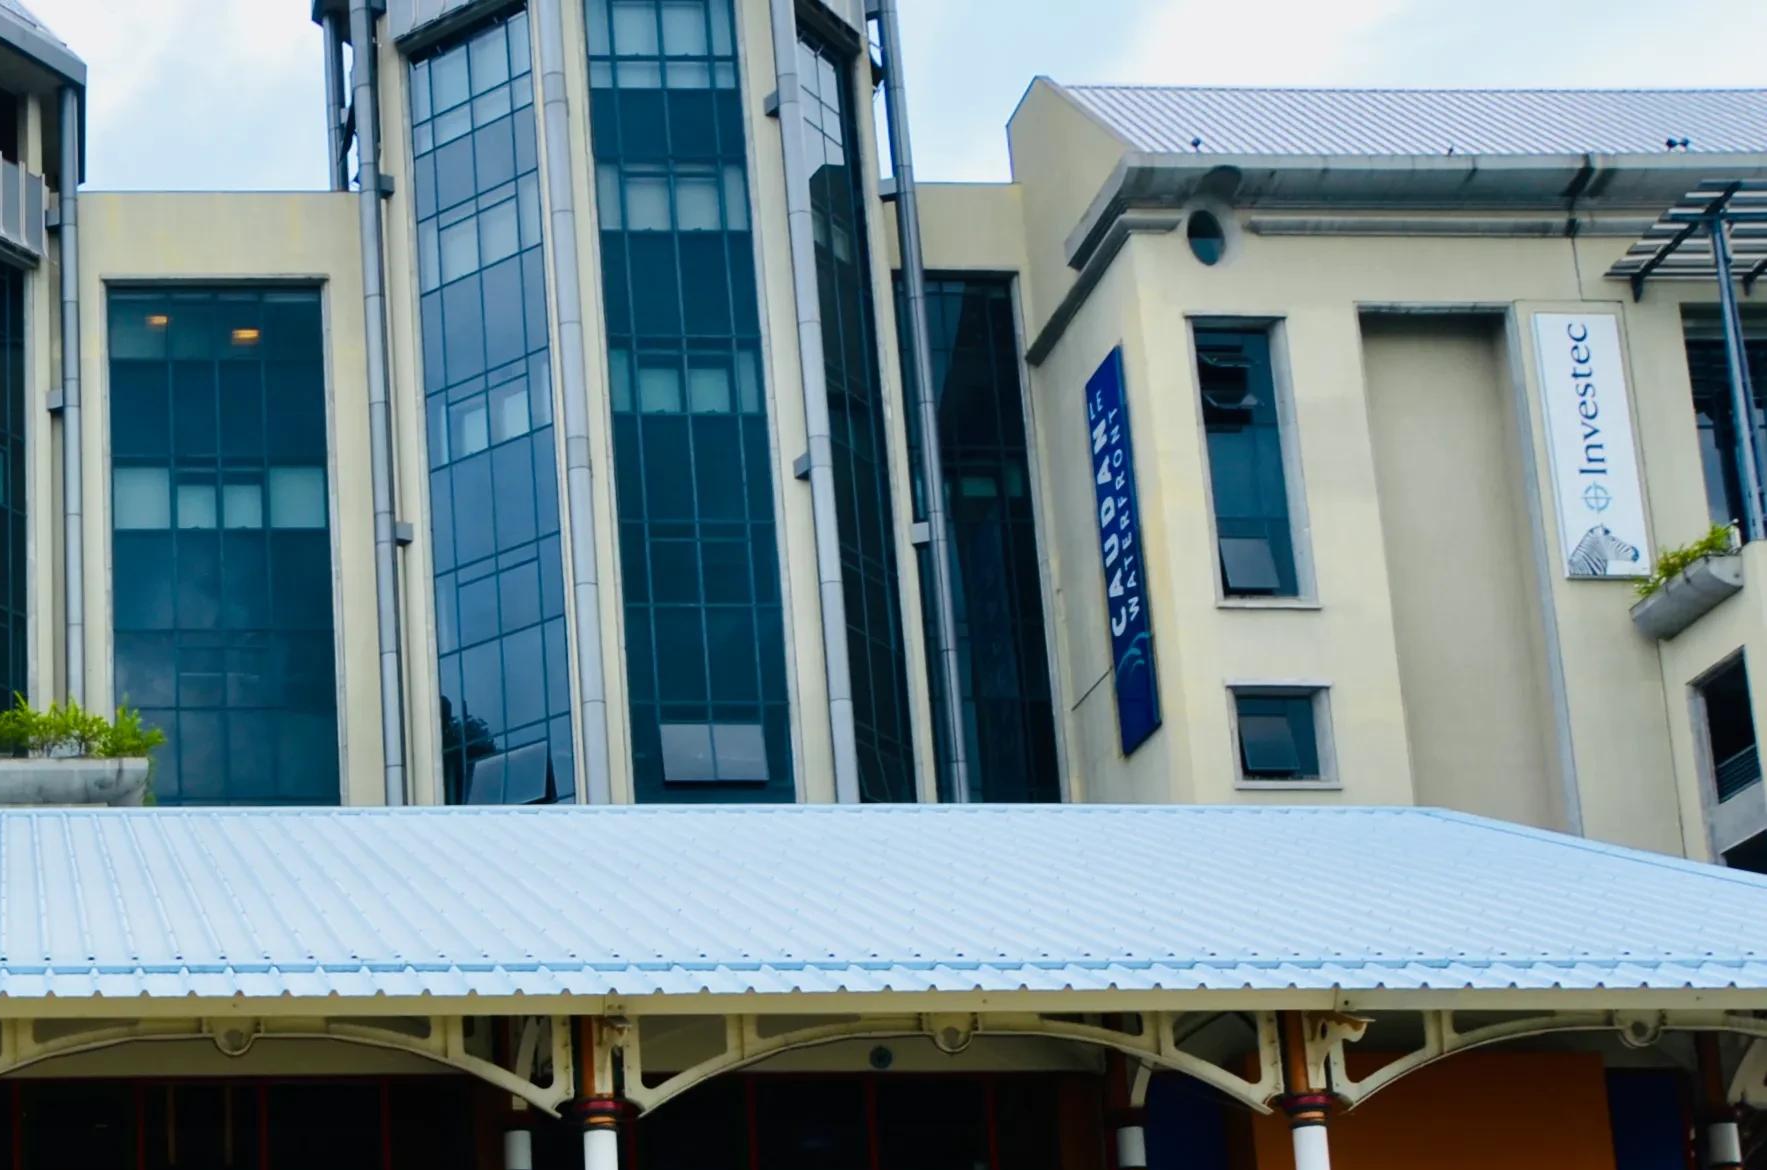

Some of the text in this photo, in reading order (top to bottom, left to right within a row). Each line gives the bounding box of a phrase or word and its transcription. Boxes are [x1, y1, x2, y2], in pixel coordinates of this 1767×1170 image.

[1089, 389, 1105, 420] LE
[1567, 322, 1608, 475] Investec
[1092, 418, 1128, 637] CAUDAN
[1108, 407, 1141, 622] WATERFRONT
